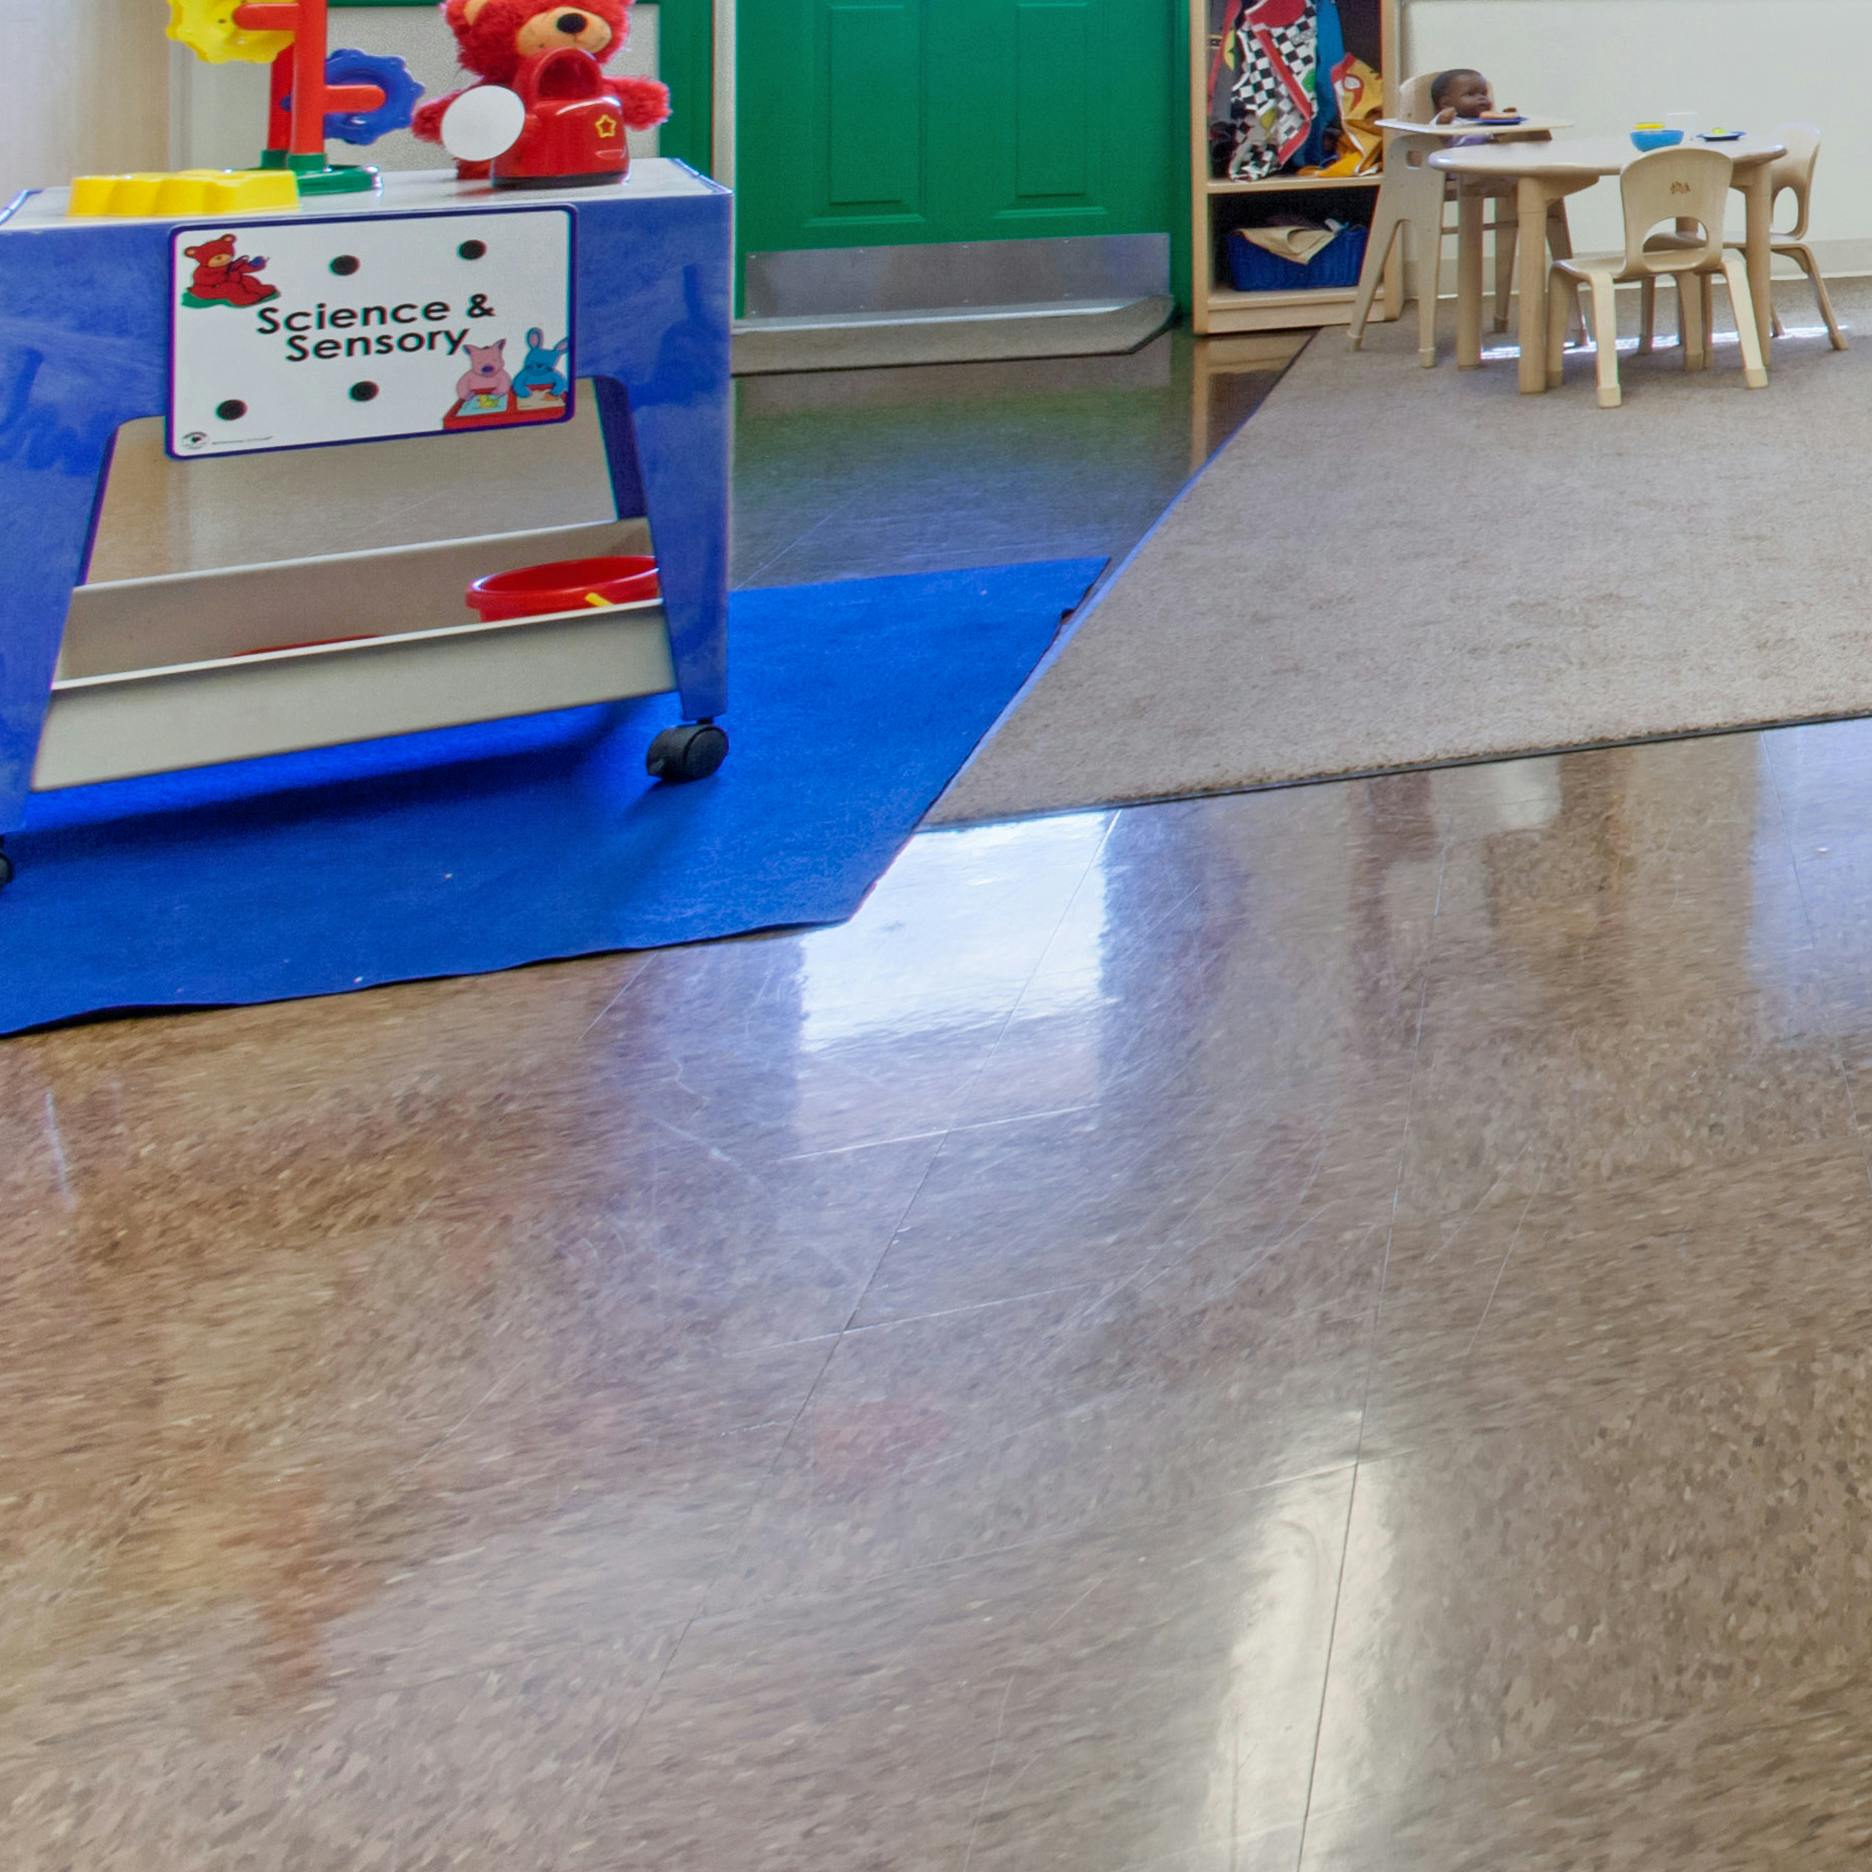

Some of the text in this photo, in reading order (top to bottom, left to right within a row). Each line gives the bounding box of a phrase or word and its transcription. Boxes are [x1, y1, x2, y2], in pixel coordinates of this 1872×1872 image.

[256, 292, 497, 334] Science &
[285, 328, 470, 362] Sensory
